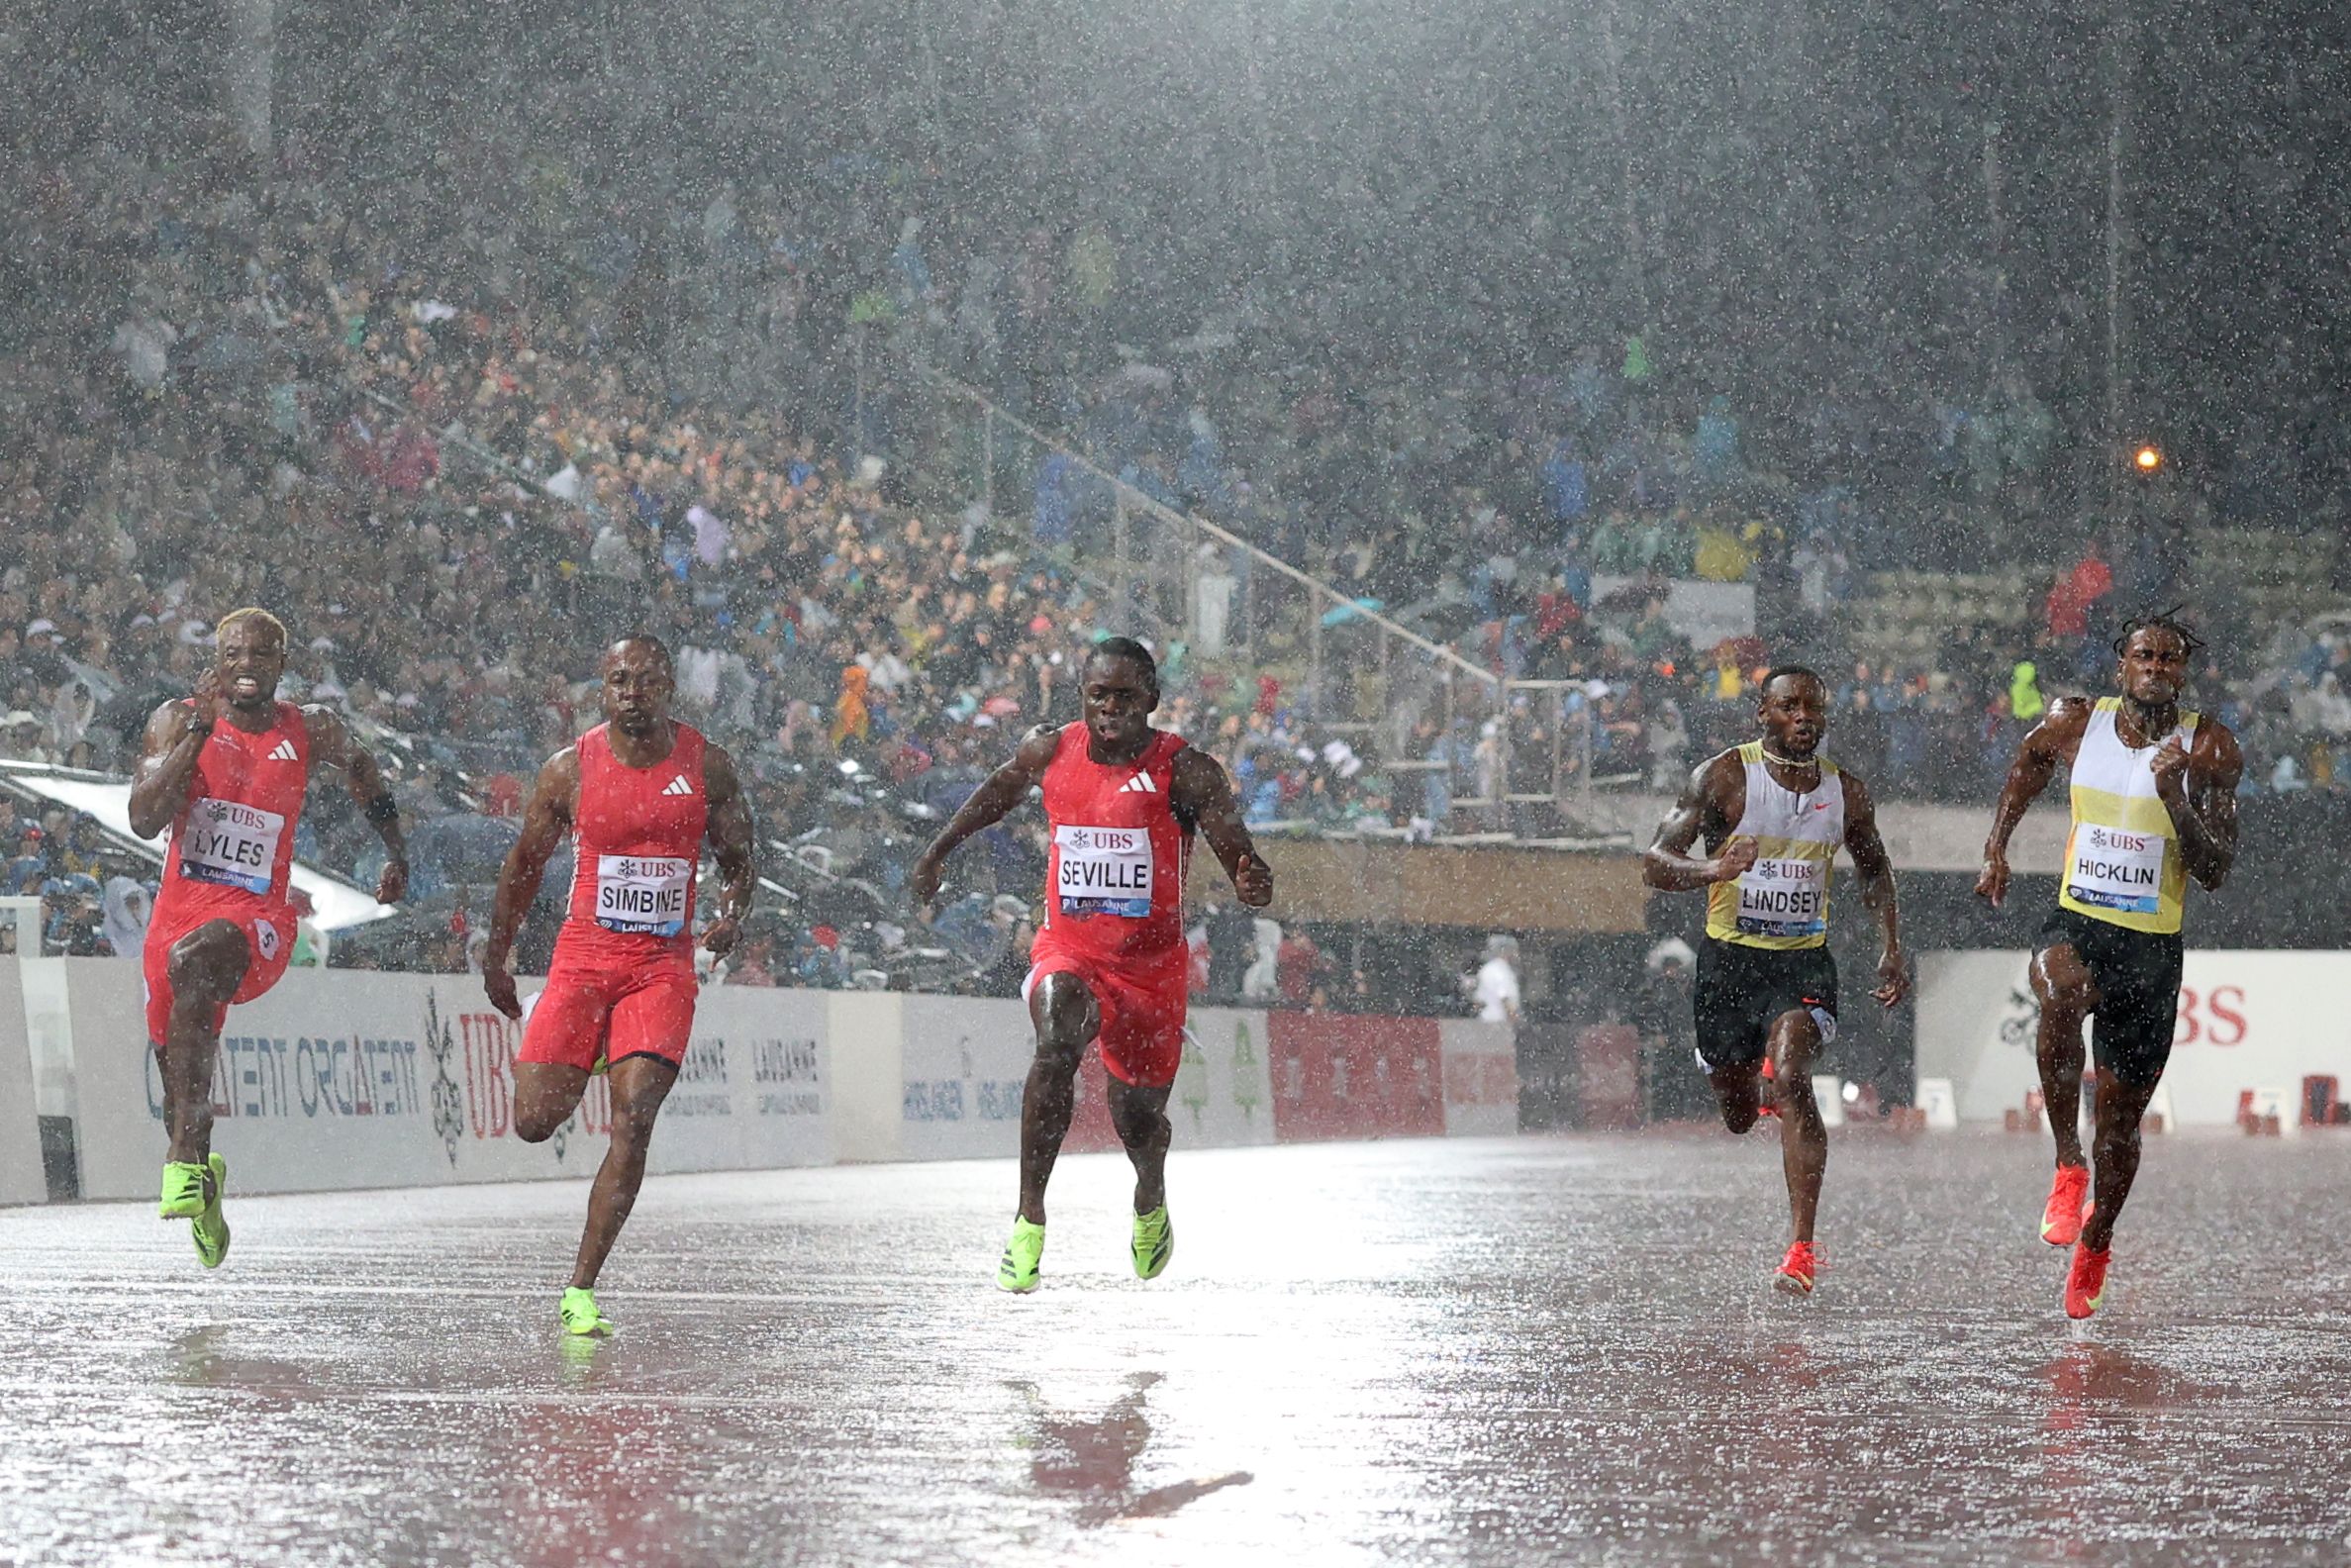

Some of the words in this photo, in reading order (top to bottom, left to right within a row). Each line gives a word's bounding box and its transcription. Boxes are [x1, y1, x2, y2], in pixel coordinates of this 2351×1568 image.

[232, 808, 266, 830] UBS
[194, 829, 264, 867] LYLES
[1094, 833, 1132, 849] UBS
[2110, 833, 2145, 851] UBS
[640, 861, 676, 878] UBS
[1061, 860, 1148, 889] SEVILLE
[1781, 863, 1815, 880] UBS
[2078, 858, 2154, 885] HICKLIN
[602, 886, 683, 914] SIMBINE
[1074, 898, 1130, 913] LAUSANNE
[1742, 888, 1821, 914] LINDSEY
[2088, 893, 2139, 907] LAUSANNE
[262, 931, 275, 948] 5
[2177, 985, 2248, 1047] BS
[296, 1034, 420, 1118] ORGATENT
